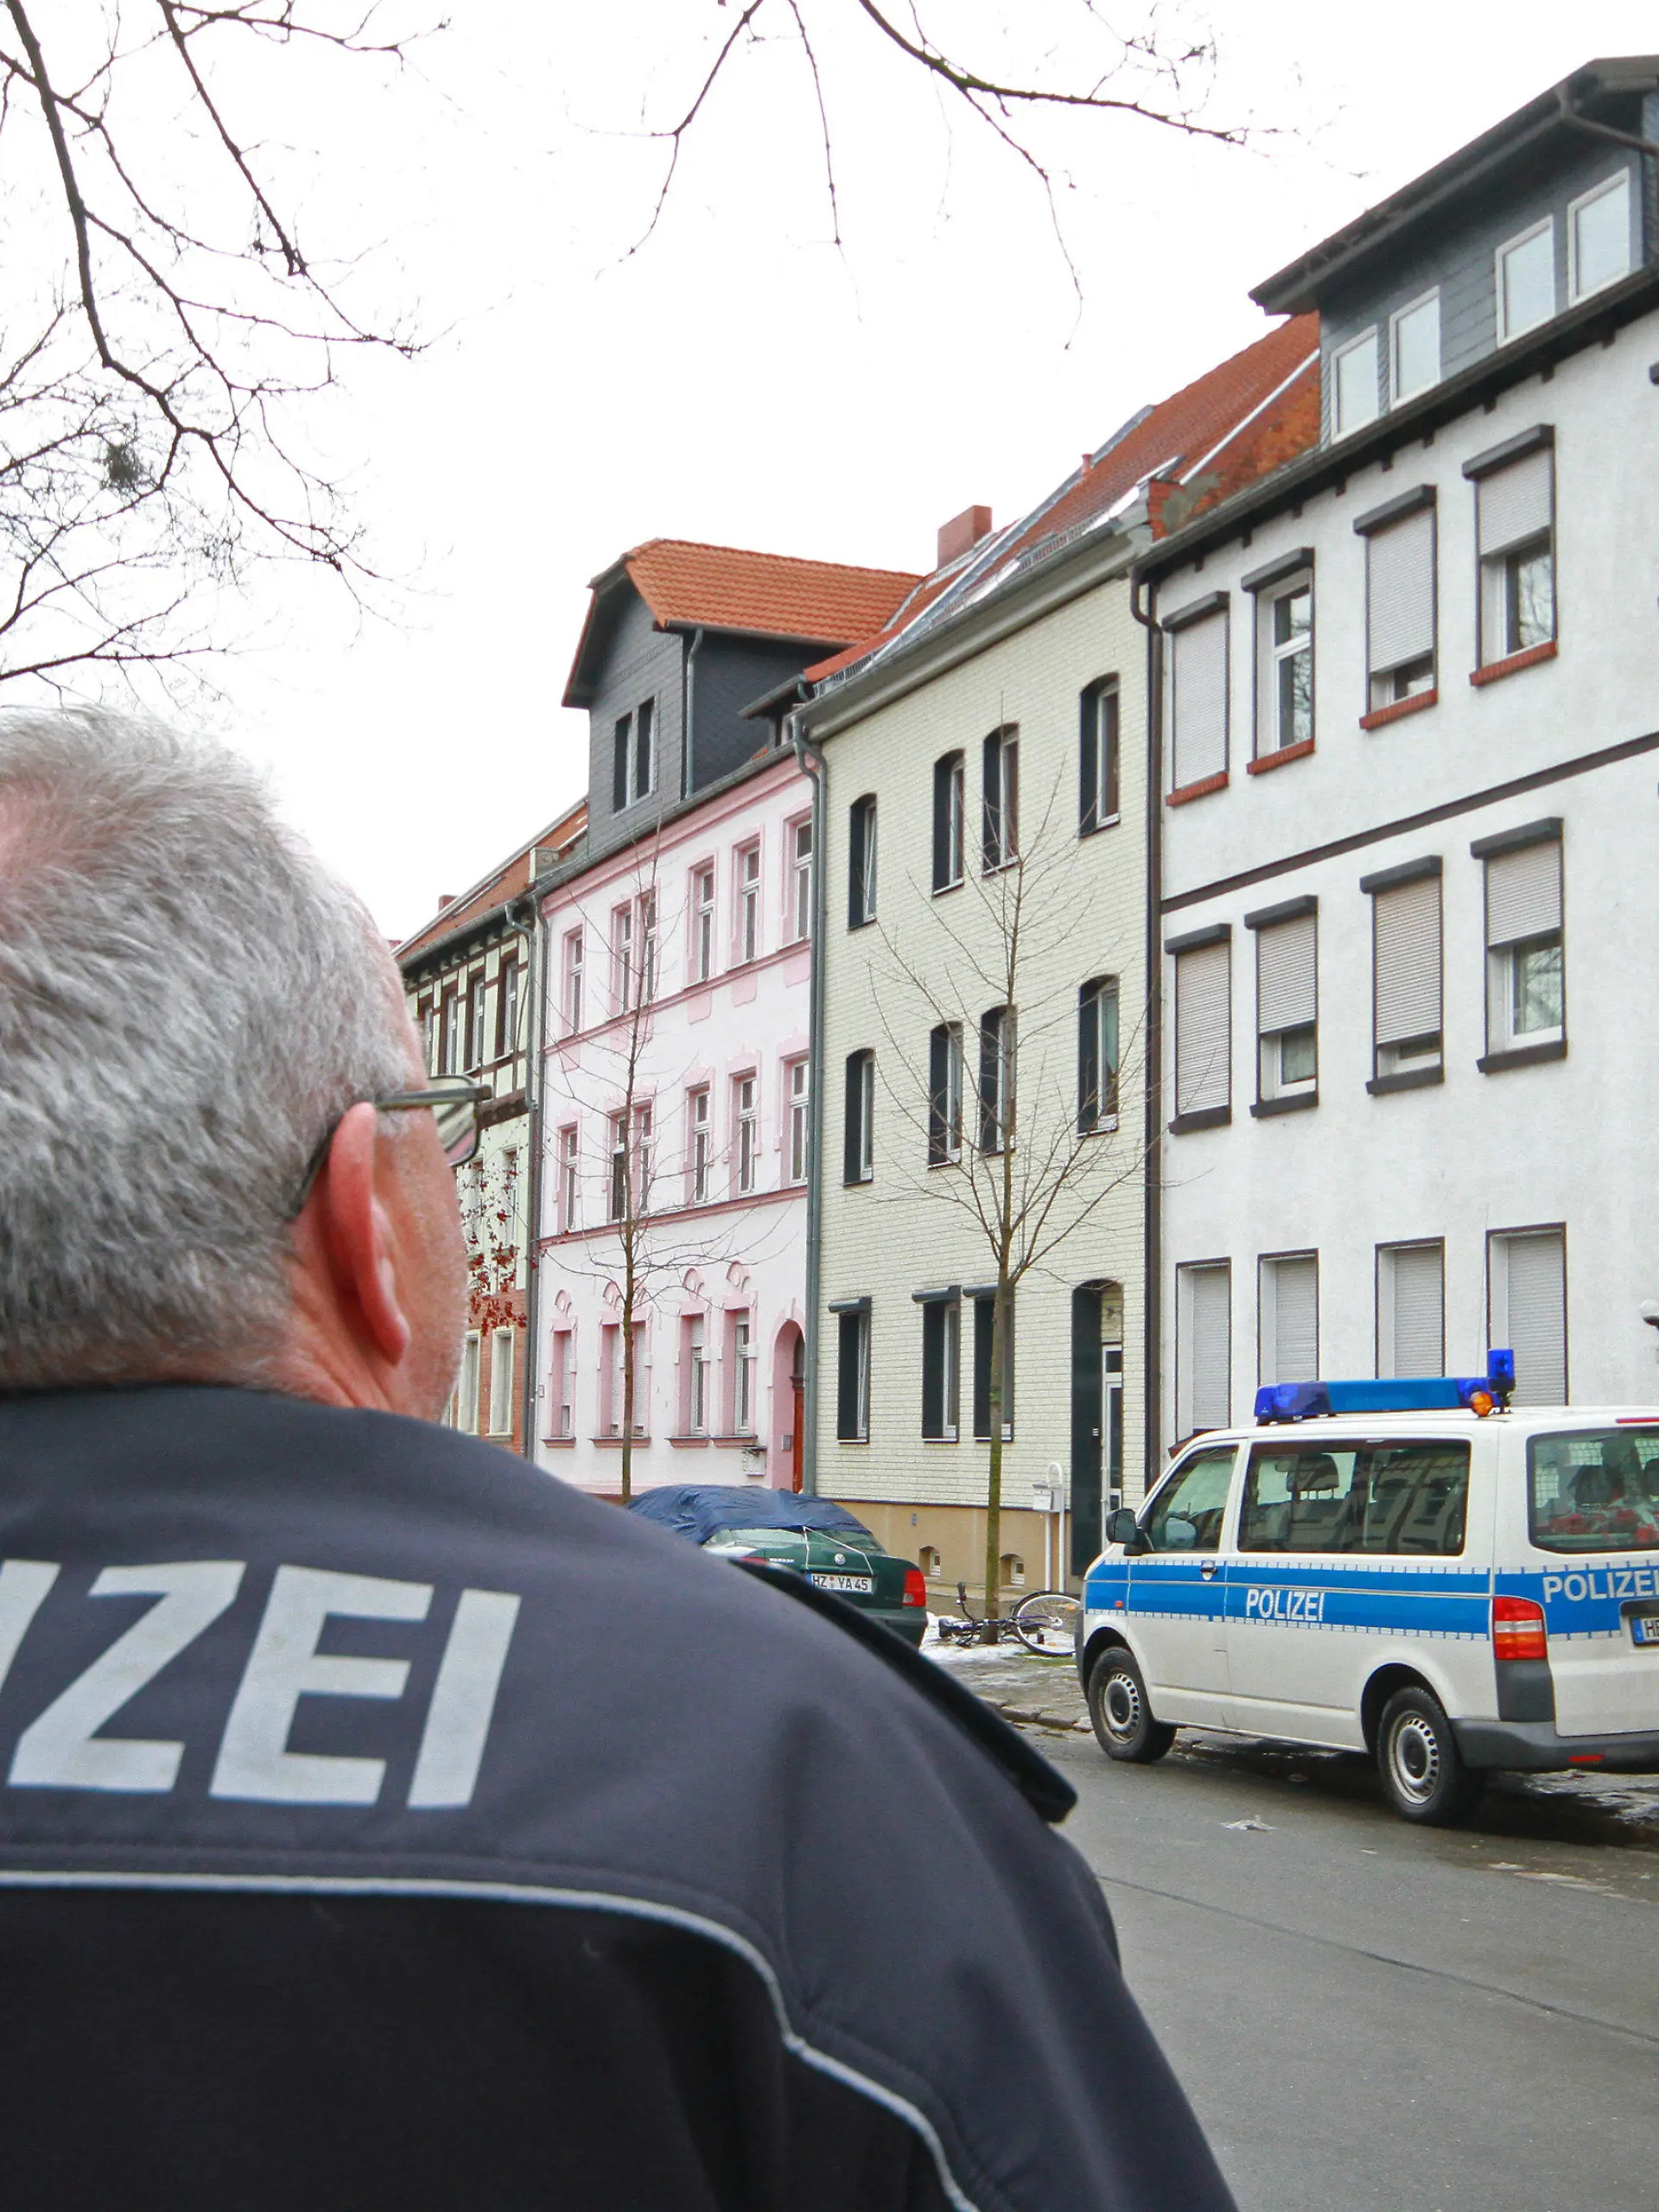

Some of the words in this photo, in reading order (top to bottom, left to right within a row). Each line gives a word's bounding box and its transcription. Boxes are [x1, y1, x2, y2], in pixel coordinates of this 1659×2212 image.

[812, 1575, 827, 1588] HZ
[838, 1577, 853, 1589] YA
[855, 1579, 868, 1591] 45
[1246, 1588, 1324, 1622] POLIZEI
